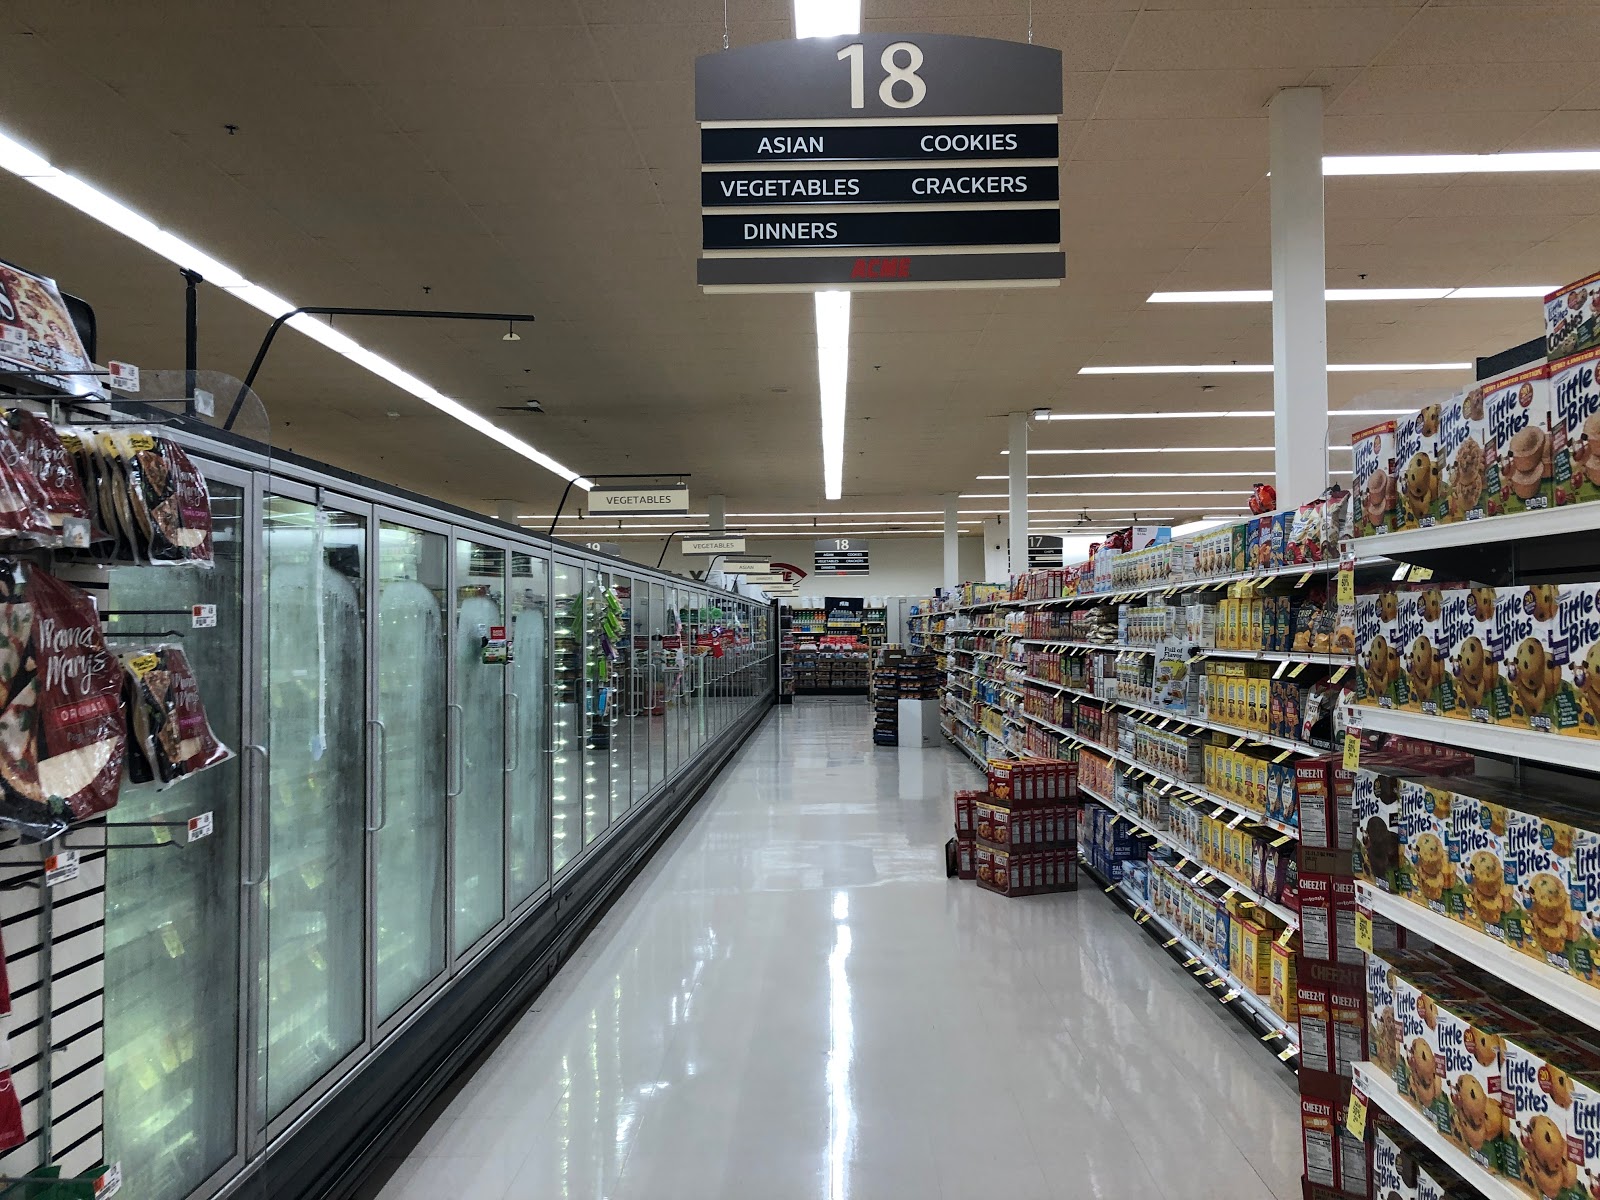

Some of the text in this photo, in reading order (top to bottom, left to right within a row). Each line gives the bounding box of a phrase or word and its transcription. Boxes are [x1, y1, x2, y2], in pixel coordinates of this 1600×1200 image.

[836, 41, 927, 109] 18
[757, 136, 824, 154] ASIAN
[920, 133, 1018, 152] COOKIES
[720, 178, 860, 197] VEGETABLES
[911, 176, 1028, 194] CRACKERS
[743, 222, 838, 240] DINNERS
[851, 258, 912, 278] ACME
[1547, 310, 1583, 353] Cookies
[1556, 366, 1593, 419] Little
[1440, 402, 1462, 445] Little
[1488, 389, 1518, 437] Little
[1567, 391, 1600, 433] Bite
[1395, 419, 1415, 458] Little
[1446, 421, 1470, 457] Bites
[1497, 408, 1530, 449] Bites
[1355, 440, 1373, 475] Little
[1399, 436, 1421, 470] Bites
[1360, 456, 1379, 486] Bites
[606, 495, 672, 505] VEGETABLES
[585, 543, 601, 552] 19
[834, 539, 850, 551] 18
[1029, 536, 1043, 548] 17
[1356, 599, 1374, 634] Little
[1397, 597, 1416, 634] Little
[1442, 594, 1466, 635] Little
[1495, 590, 1522, 635] Little
[1558, 590, 1593, 636] Little
[1361, 618, 1381, 646] Bites
[1402, 619, 1424, 647] Bites
[1449, 617, 1475, 648] Bites
[1503, 617, 1533, 652] Bites
[1568, 616, 1600, 653] Bite
[1297, 768, 1324, 779] CHEEZ-IT
[1334, 769, 1351, 779] CHEE
[1355, 777, 1373, 807] Little
[1401, 786, 1424, 821] Little
[1360, 799, 1379, 821] Bites
[1452, 801, 1479, 838] Little
[1407, 813, 1432, 838] Bites
[1508, 818, 1539, 858] Little
[1460, 829, 1489, 851] Bites
[1517, 849, 1551, 877] Bites
[1299, 879, 1327, 891] CHEEZ-IT
[1333, 882, 1355, 893] CHEEZ
[1368, 964, 1386, 992] Little
[1298, 988, 1325, 1002] CHEEZ-IT
[1331, 994, 1360, 1009] CHEEZ-IT
[1373, 987, 1393, 1007] Bites
[1396, 990, 1416, 1020] Little
[1402, 1014, 1424, 1037] Bites
[1437, 1022, 1463, 1053] Little
[1445, 1048, 1473, 1072] Bites
[1506, 1058, 1537, 1091] Little
[1539, 1070, 1549, 1081] 20
[1302, 1101, 1330, 1116] CHEEZ-IT
[1515, 1085, 1549, 1113] Bites
[1376, 1143, 1395, 1173] Little
[1380, 1169, 1401, 1191] Bites
